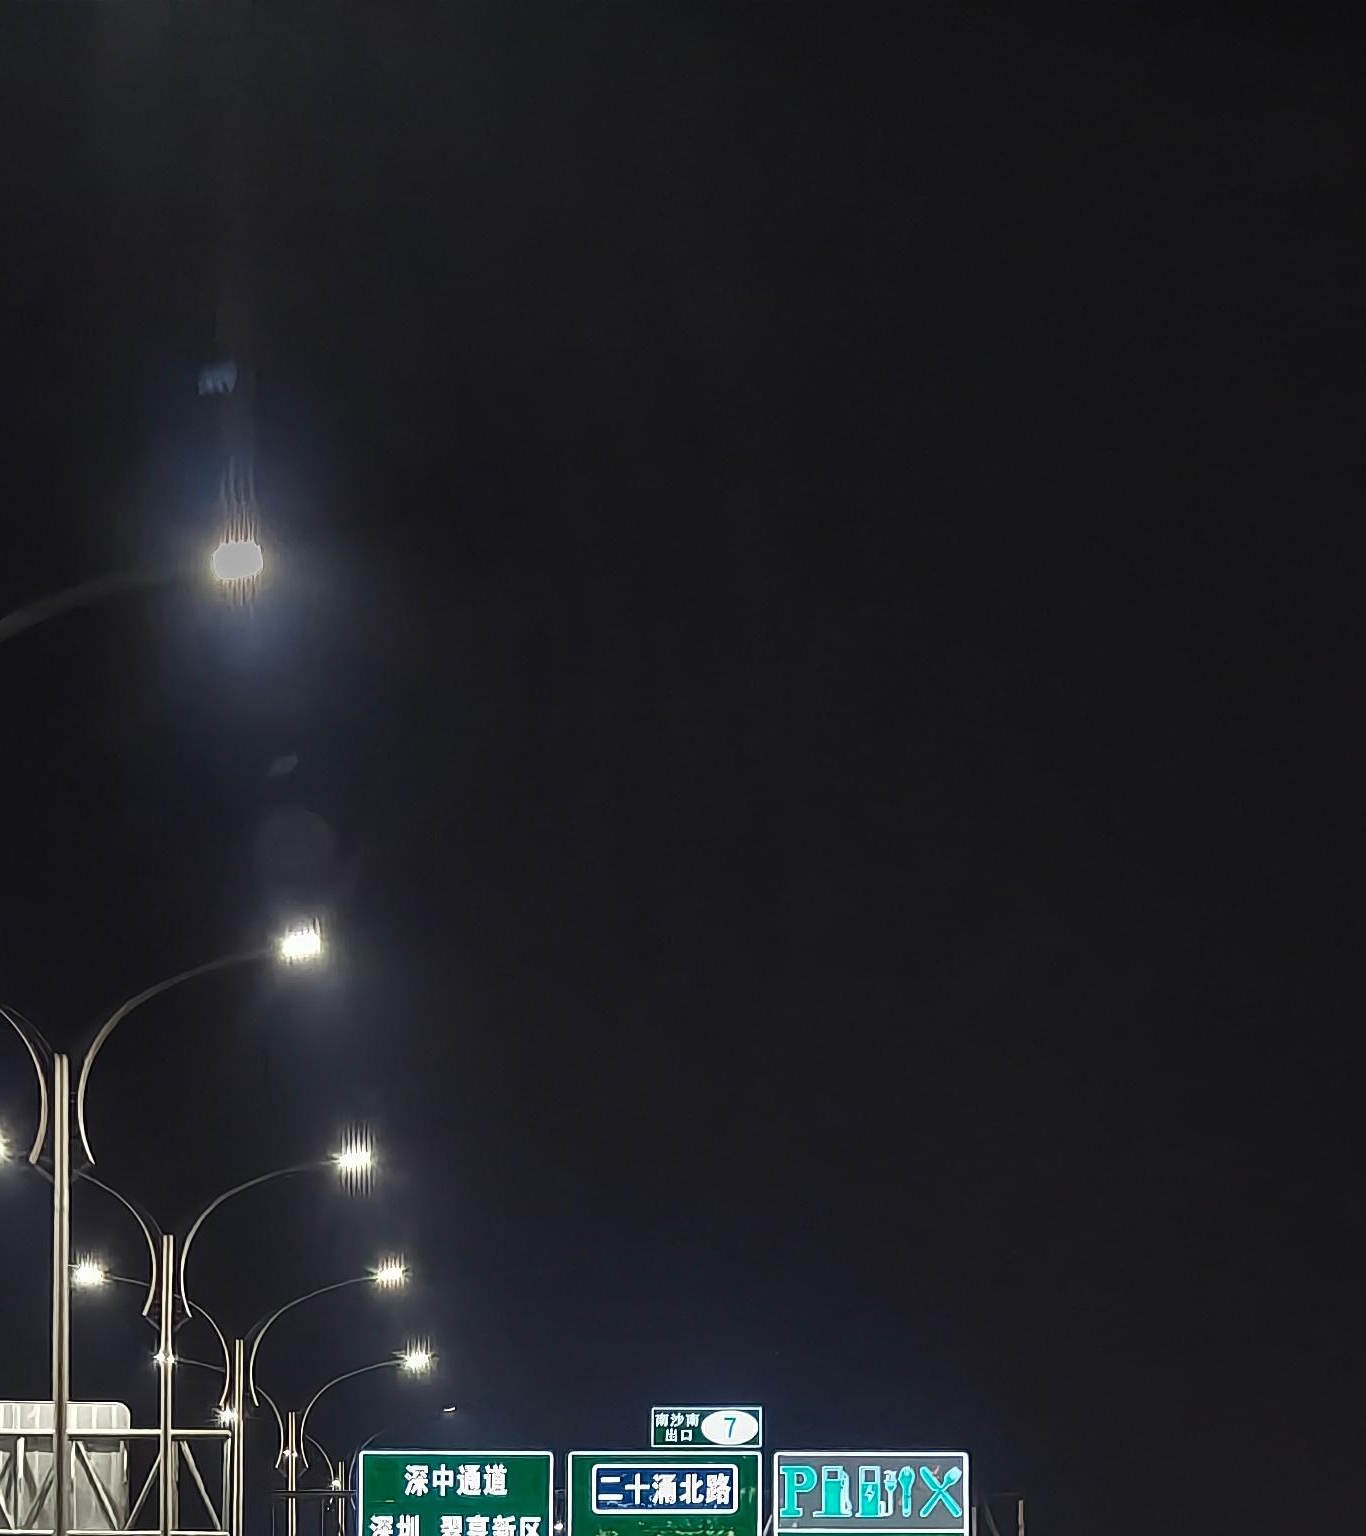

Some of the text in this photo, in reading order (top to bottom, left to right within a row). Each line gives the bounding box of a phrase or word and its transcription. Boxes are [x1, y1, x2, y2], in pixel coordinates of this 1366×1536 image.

[654, 1412, 701, 1428] 南沙南
[723, 1417, 737, 1438] 7
[664, 1428, 693, 1442] 出口
[403, 1463, 508, 1497] 深中通道
[597, 1472, 731, 1505] 二十涌北路
